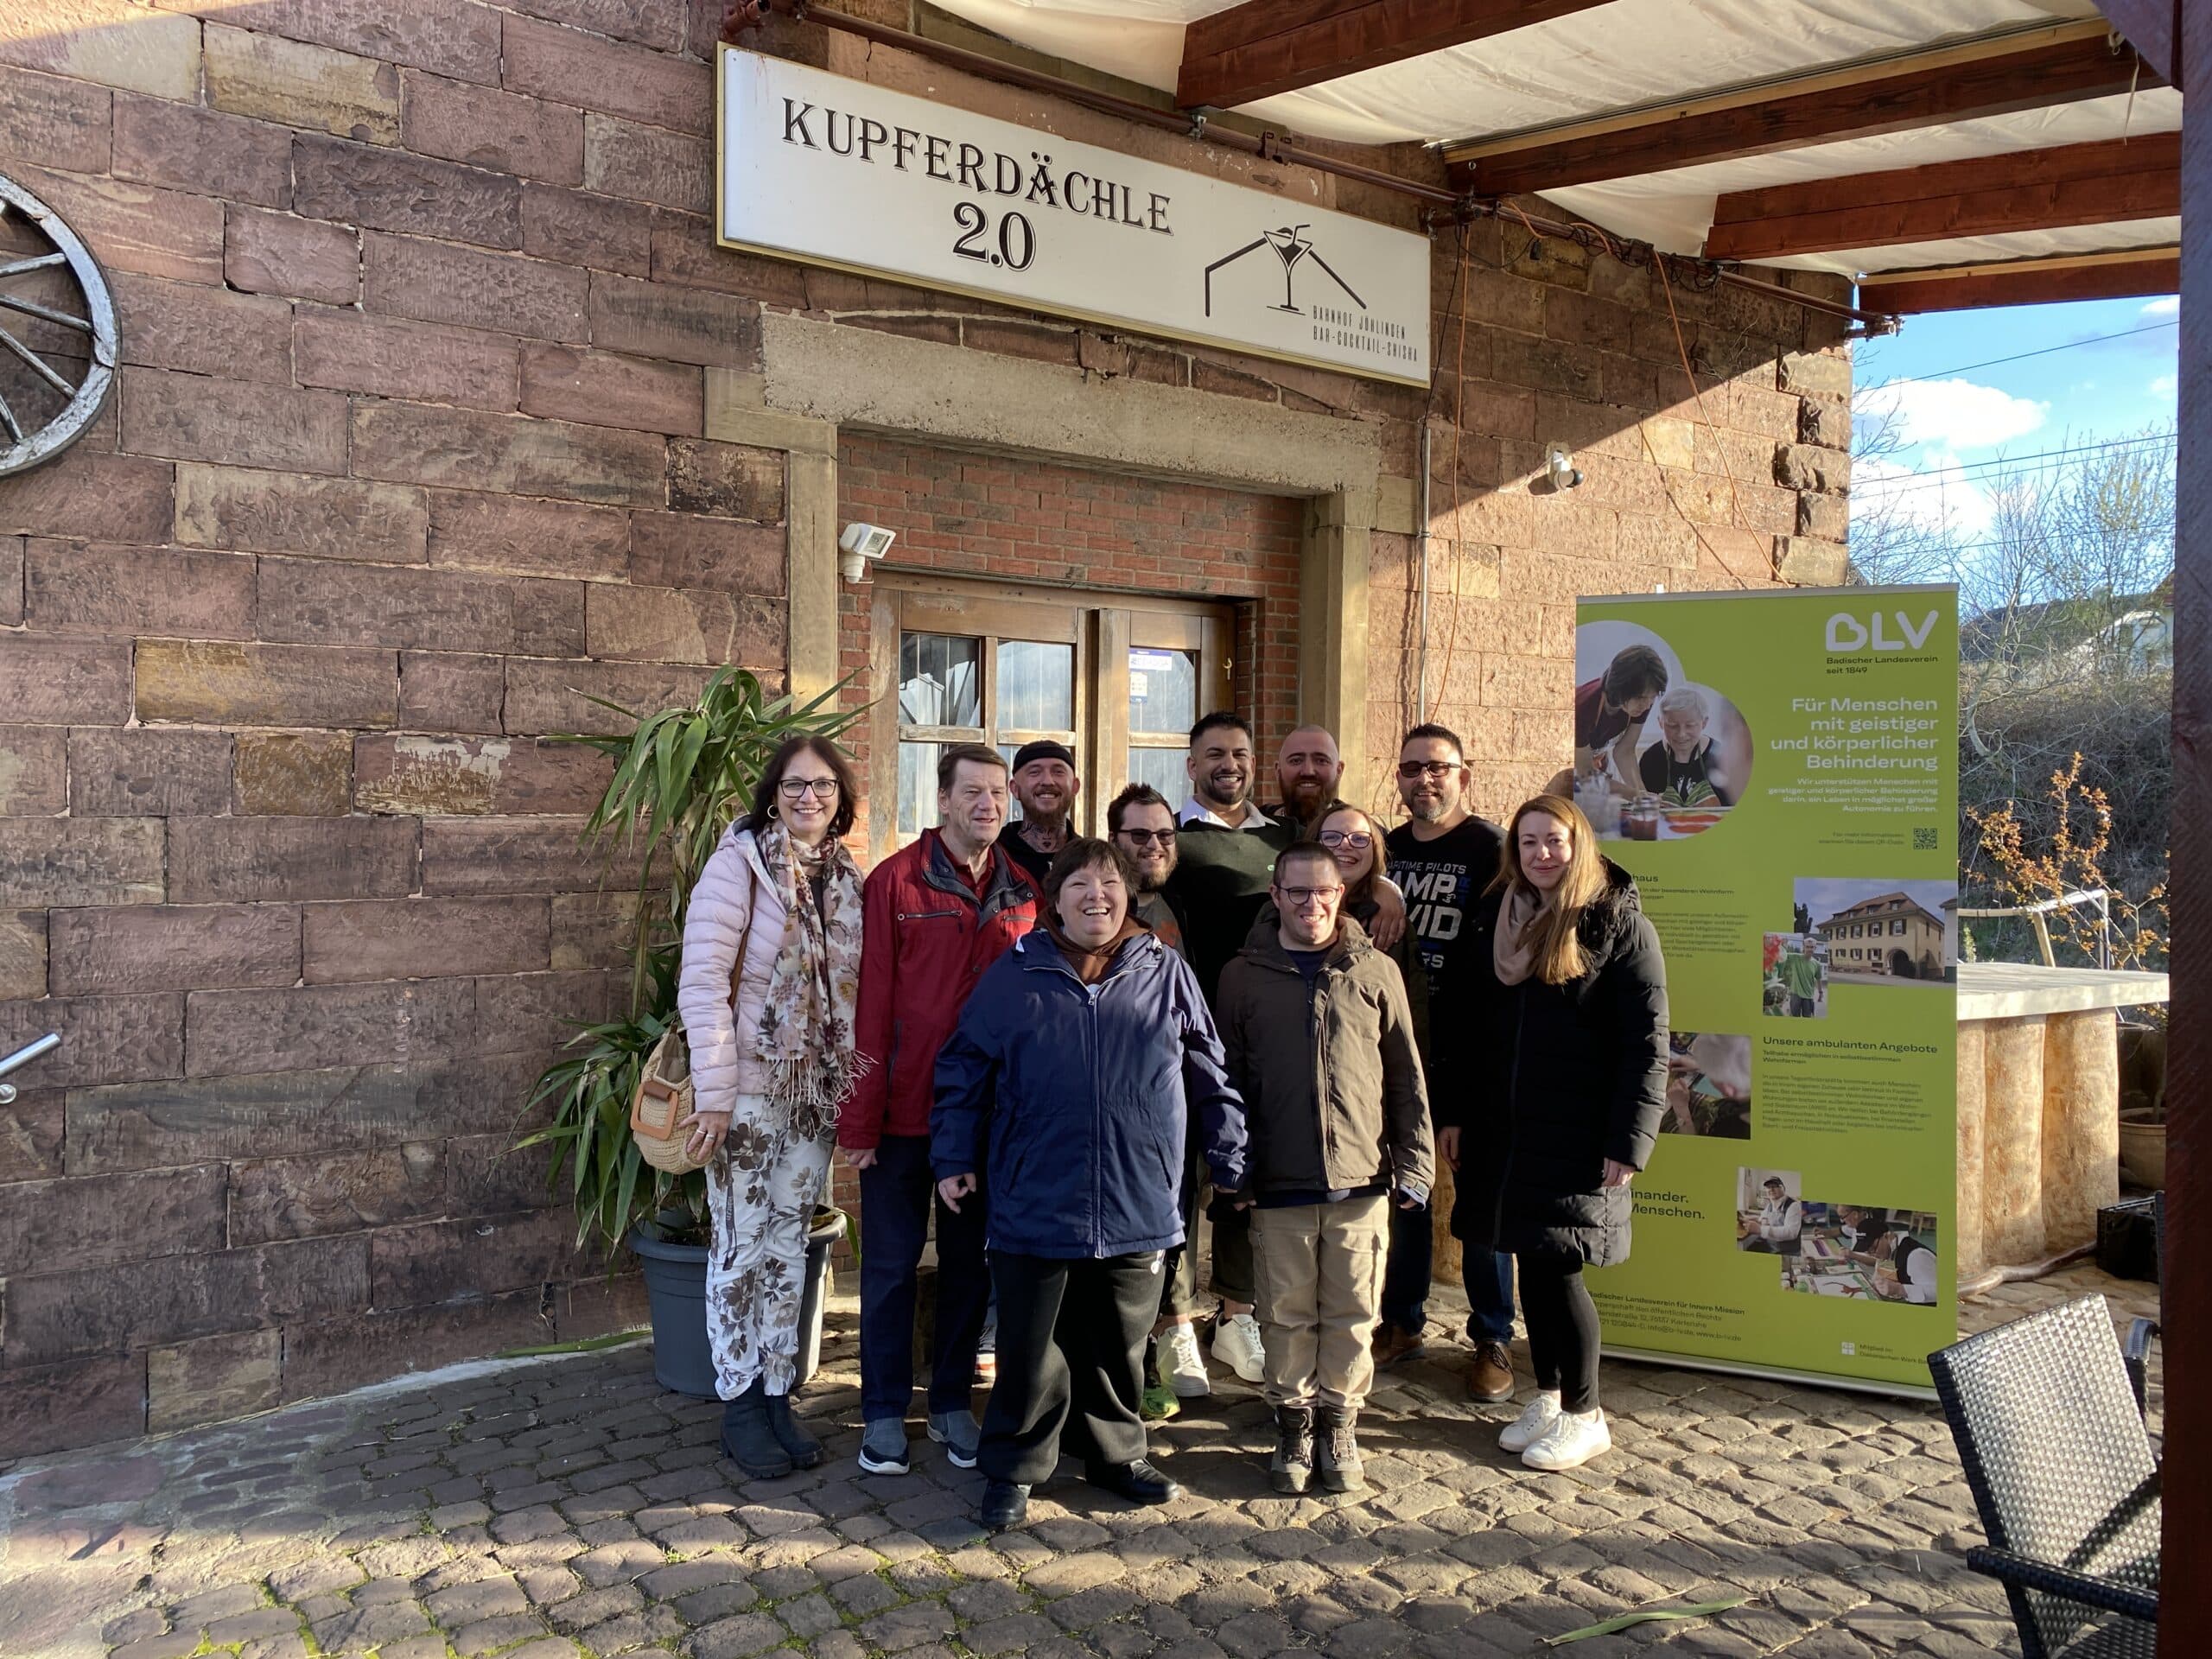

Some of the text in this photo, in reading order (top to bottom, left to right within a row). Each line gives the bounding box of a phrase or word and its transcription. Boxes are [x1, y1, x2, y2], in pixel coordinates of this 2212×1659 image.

[781, 98, 1174, 237] KUPFERDÄCHLE
[952, 200, 1036, 273] 2.0
[1313, 305, 1351, 327] BAHNHOF
[1313, 326, 1417, 362] BAR-COCKTAIL-SHISHA
[1825, 610, 1939, 652] BLV
[1792, 697, 1937, 712] Für Menschen
[1811, 716, 1938, 734] mit geistiger
[1771, 735, 1938, 752] und körperlicher
[1807, 754, 1938, 772] Behinderung
[1387, 861, 1466, 874] ARITIME PILOTS
[1386, 870, 1458, 901] AMP
[1632, 874, 1659, 882] haus
[1763, 1037, 1938, 1053] Unsere ambulanten Angebote
[1631, 1189, 1688, 1203] inander.
[1715, 1306, 1745, 1315] Mission
